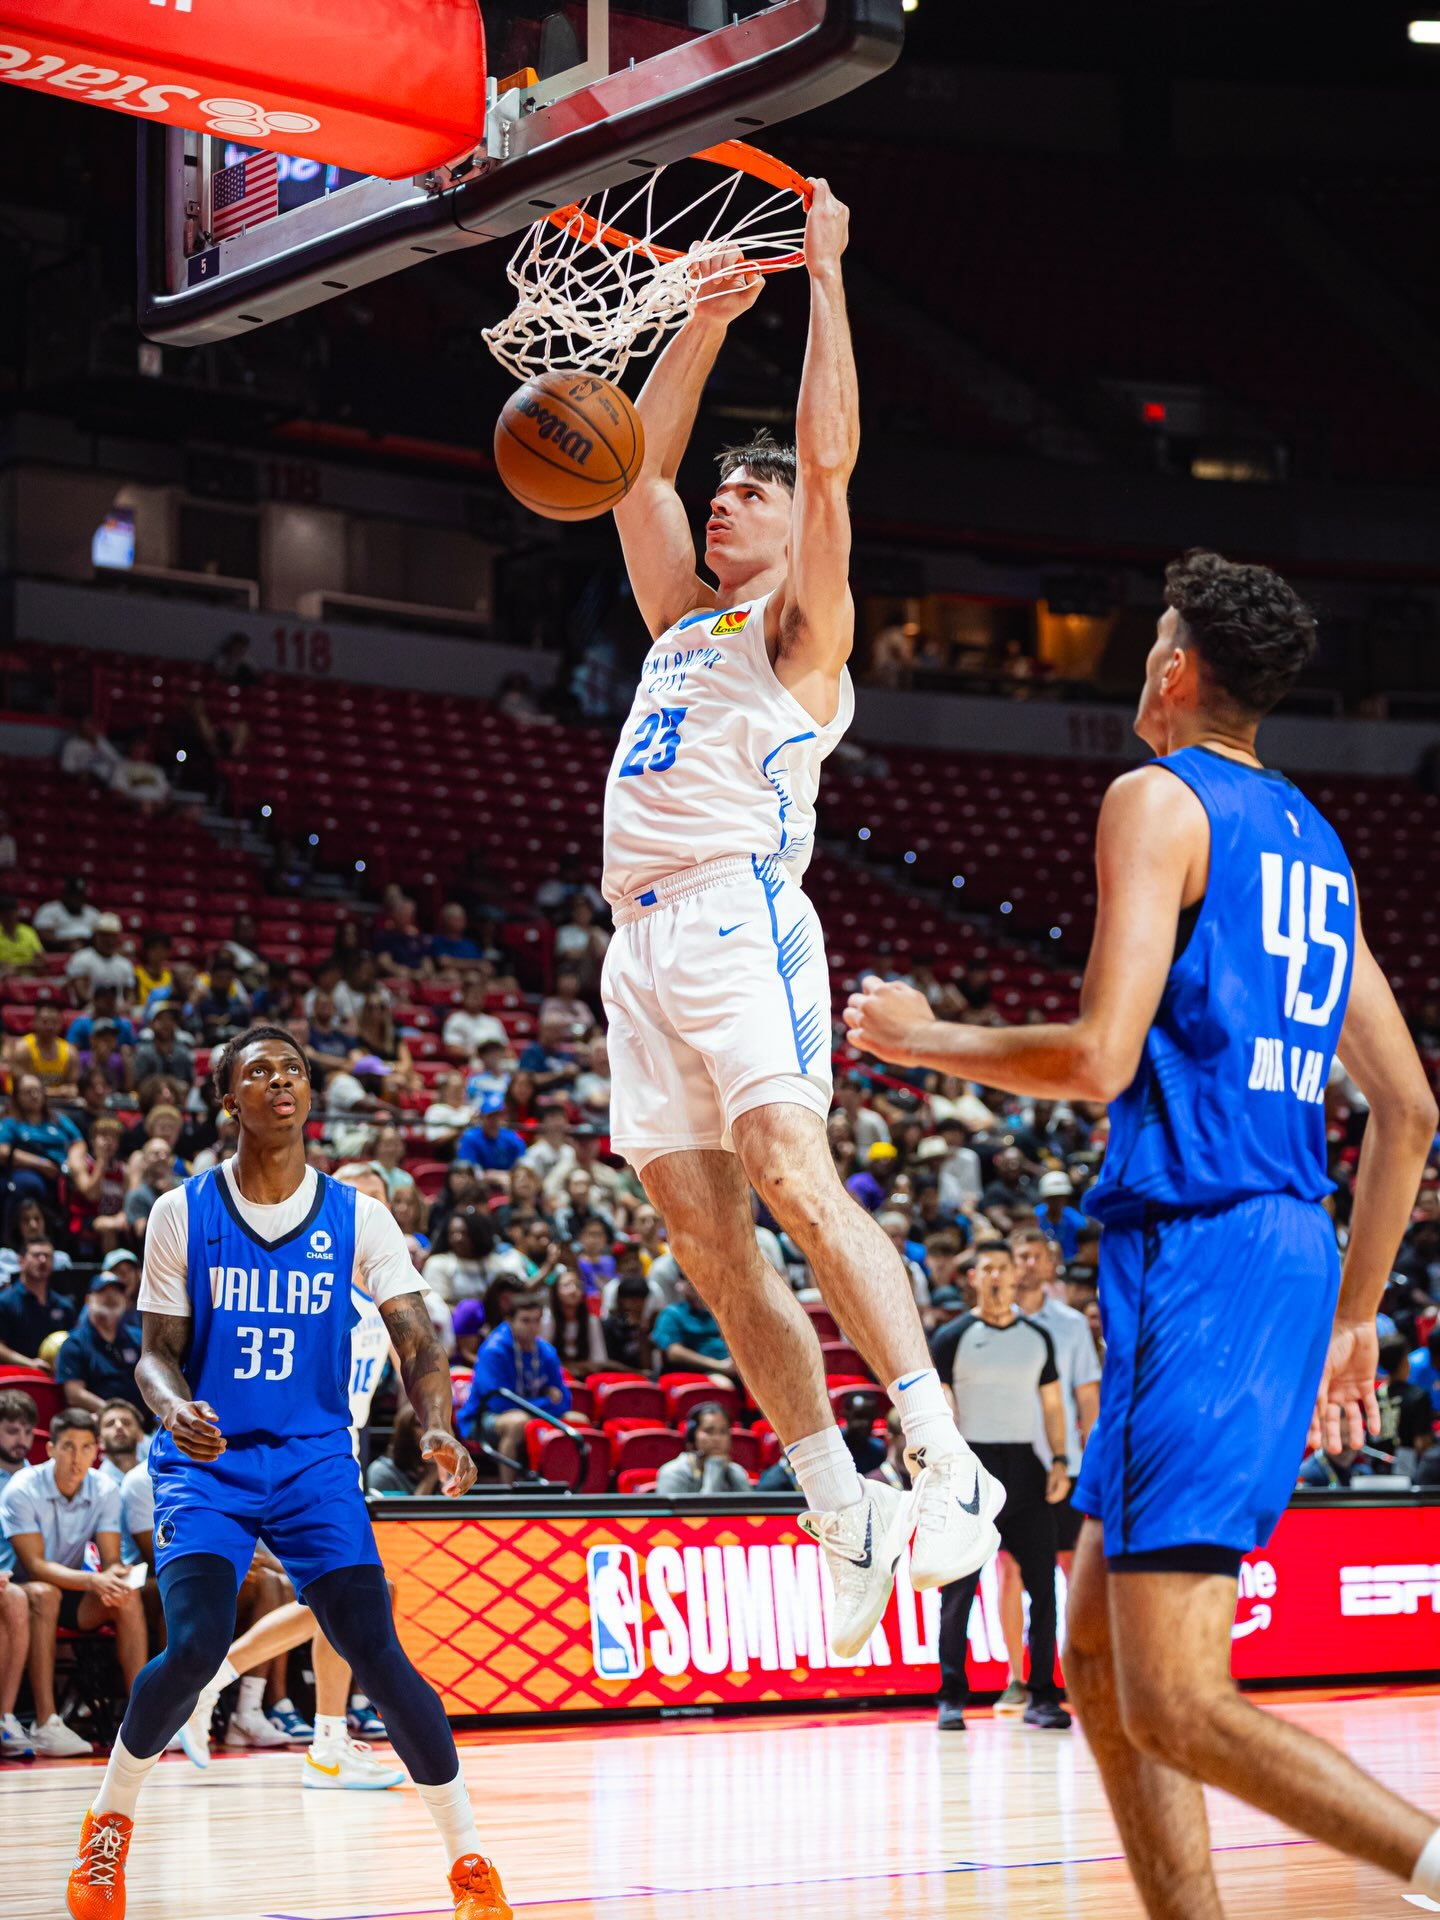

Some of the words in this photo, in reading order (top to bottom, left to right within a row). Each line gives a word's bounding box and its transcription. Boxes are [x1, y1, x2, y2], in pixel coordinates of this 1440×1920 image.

[200, 258, 207, 274] 5
[515, 396, 594, 465] Wilson
[272, 627, 332, 673] 118
[648, 672, 686, 693] CITY
[619, 707, 688, 777] 23
[1260, 851, 1350, 1027] 45
[306, 1251, 334, 1260] CHASE
[209, 1266, 334, 1315] DALLAS
[233, 1326, 296, 1381] 33
[645, 1544, 891, 1677] SUMM
